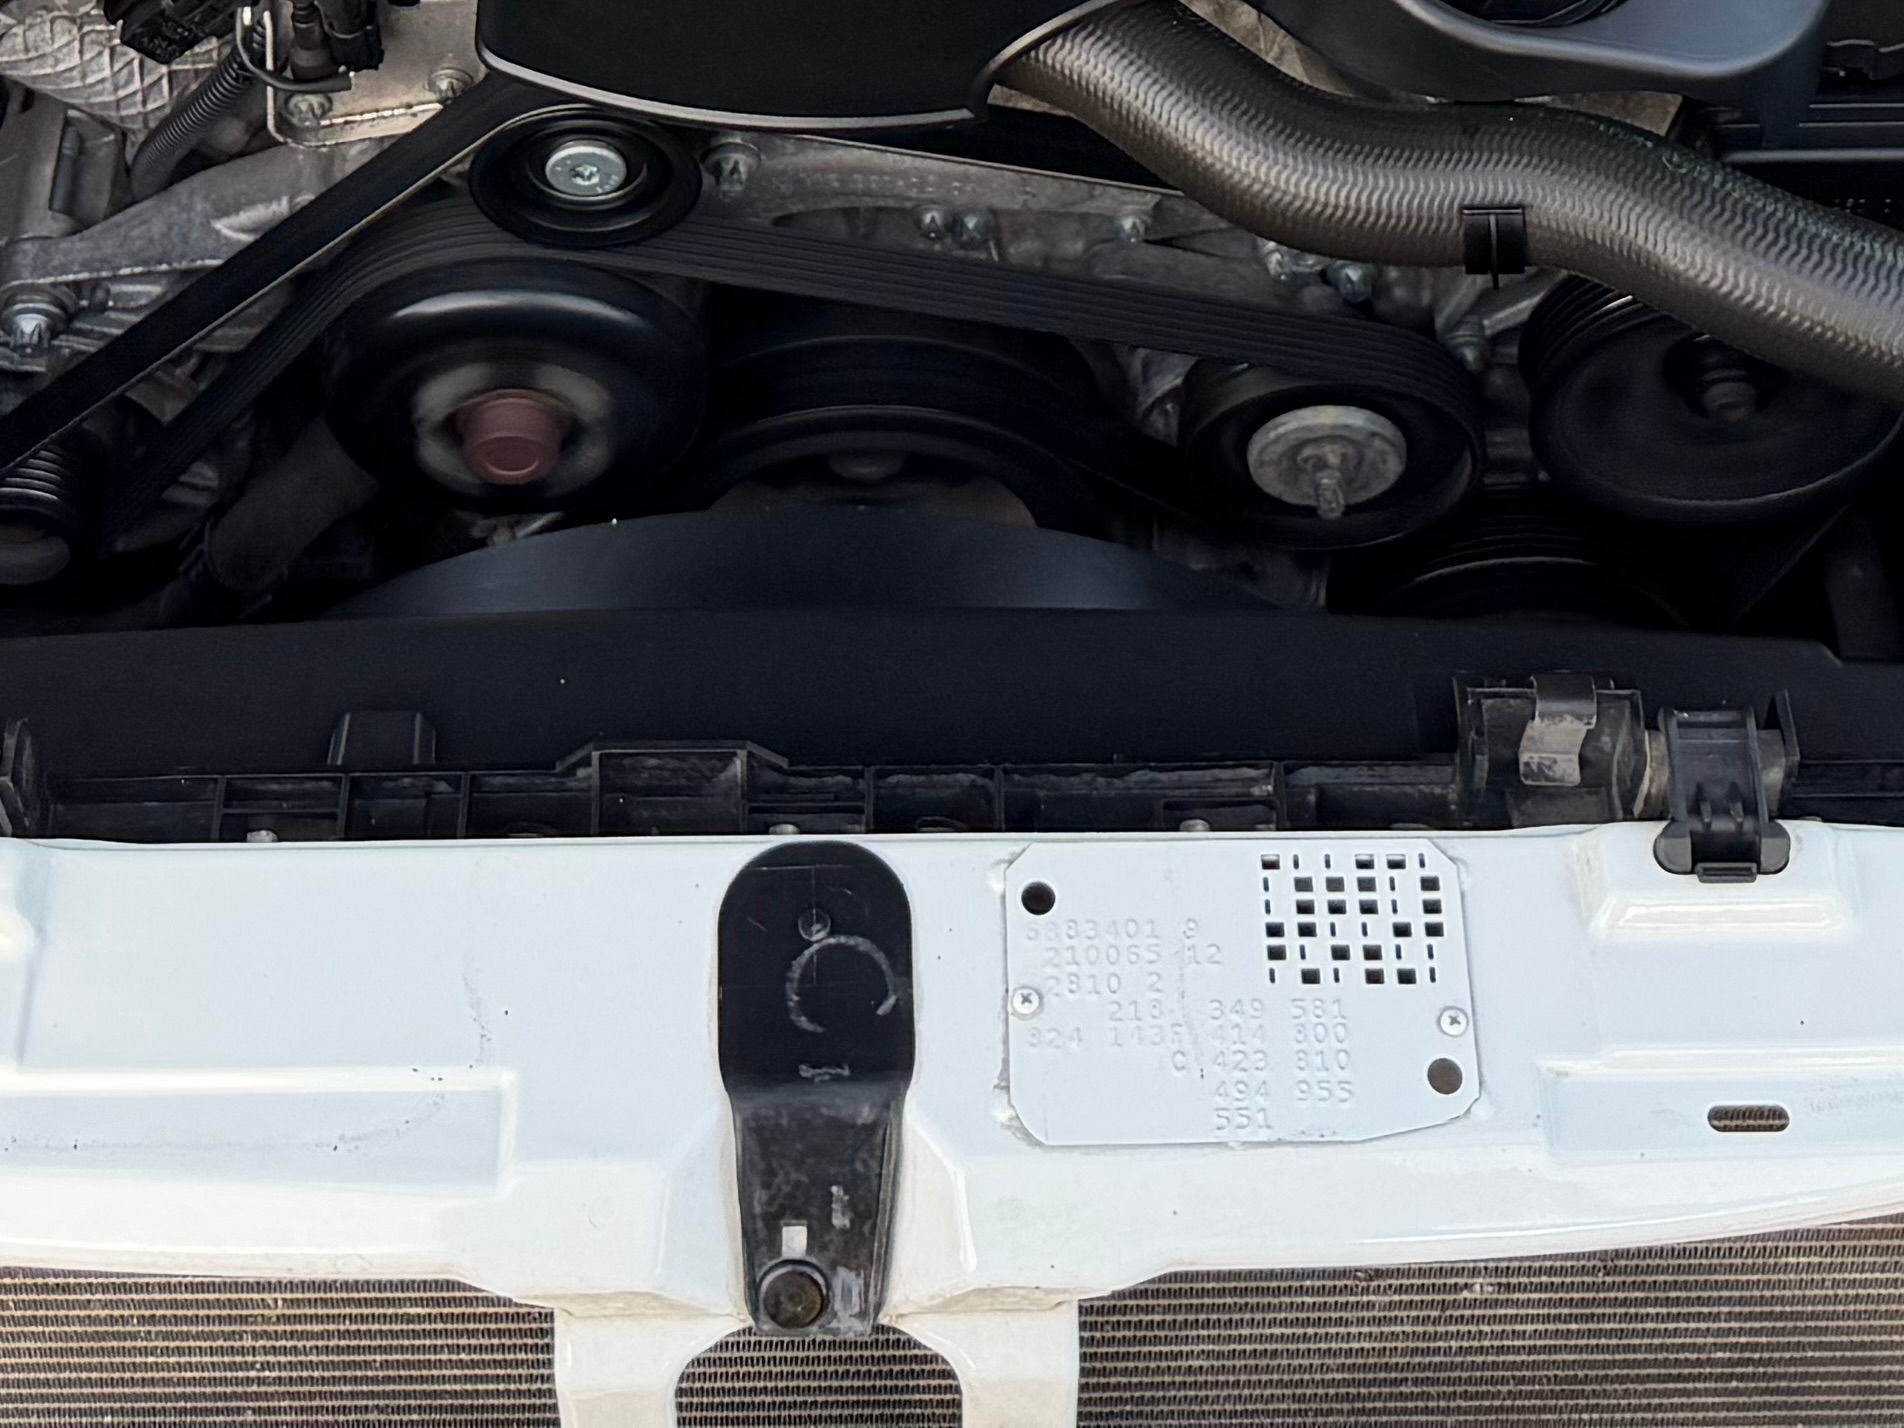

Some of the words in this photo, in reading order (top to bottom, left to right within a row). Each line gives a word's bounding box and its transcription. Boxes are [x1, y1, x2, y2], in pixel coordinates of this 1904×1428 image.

[1044, 944, 1161, 969] 210065
[1185, 944, 1223, 967] 12
[1147, 972, 1164, 995] 2
[1208, 999, 1265, 1022] 349
[1290, 998, 1349, 1021] 581
[1212, 1024, 1267, 1046] 414
[1212, 1049, 1269, 1072] 423
[1213, 1080, 1269, 1103] 494
[1295, 1080, 1354, 1104] 955
[1214, 1107, 1273, 1131] 551
